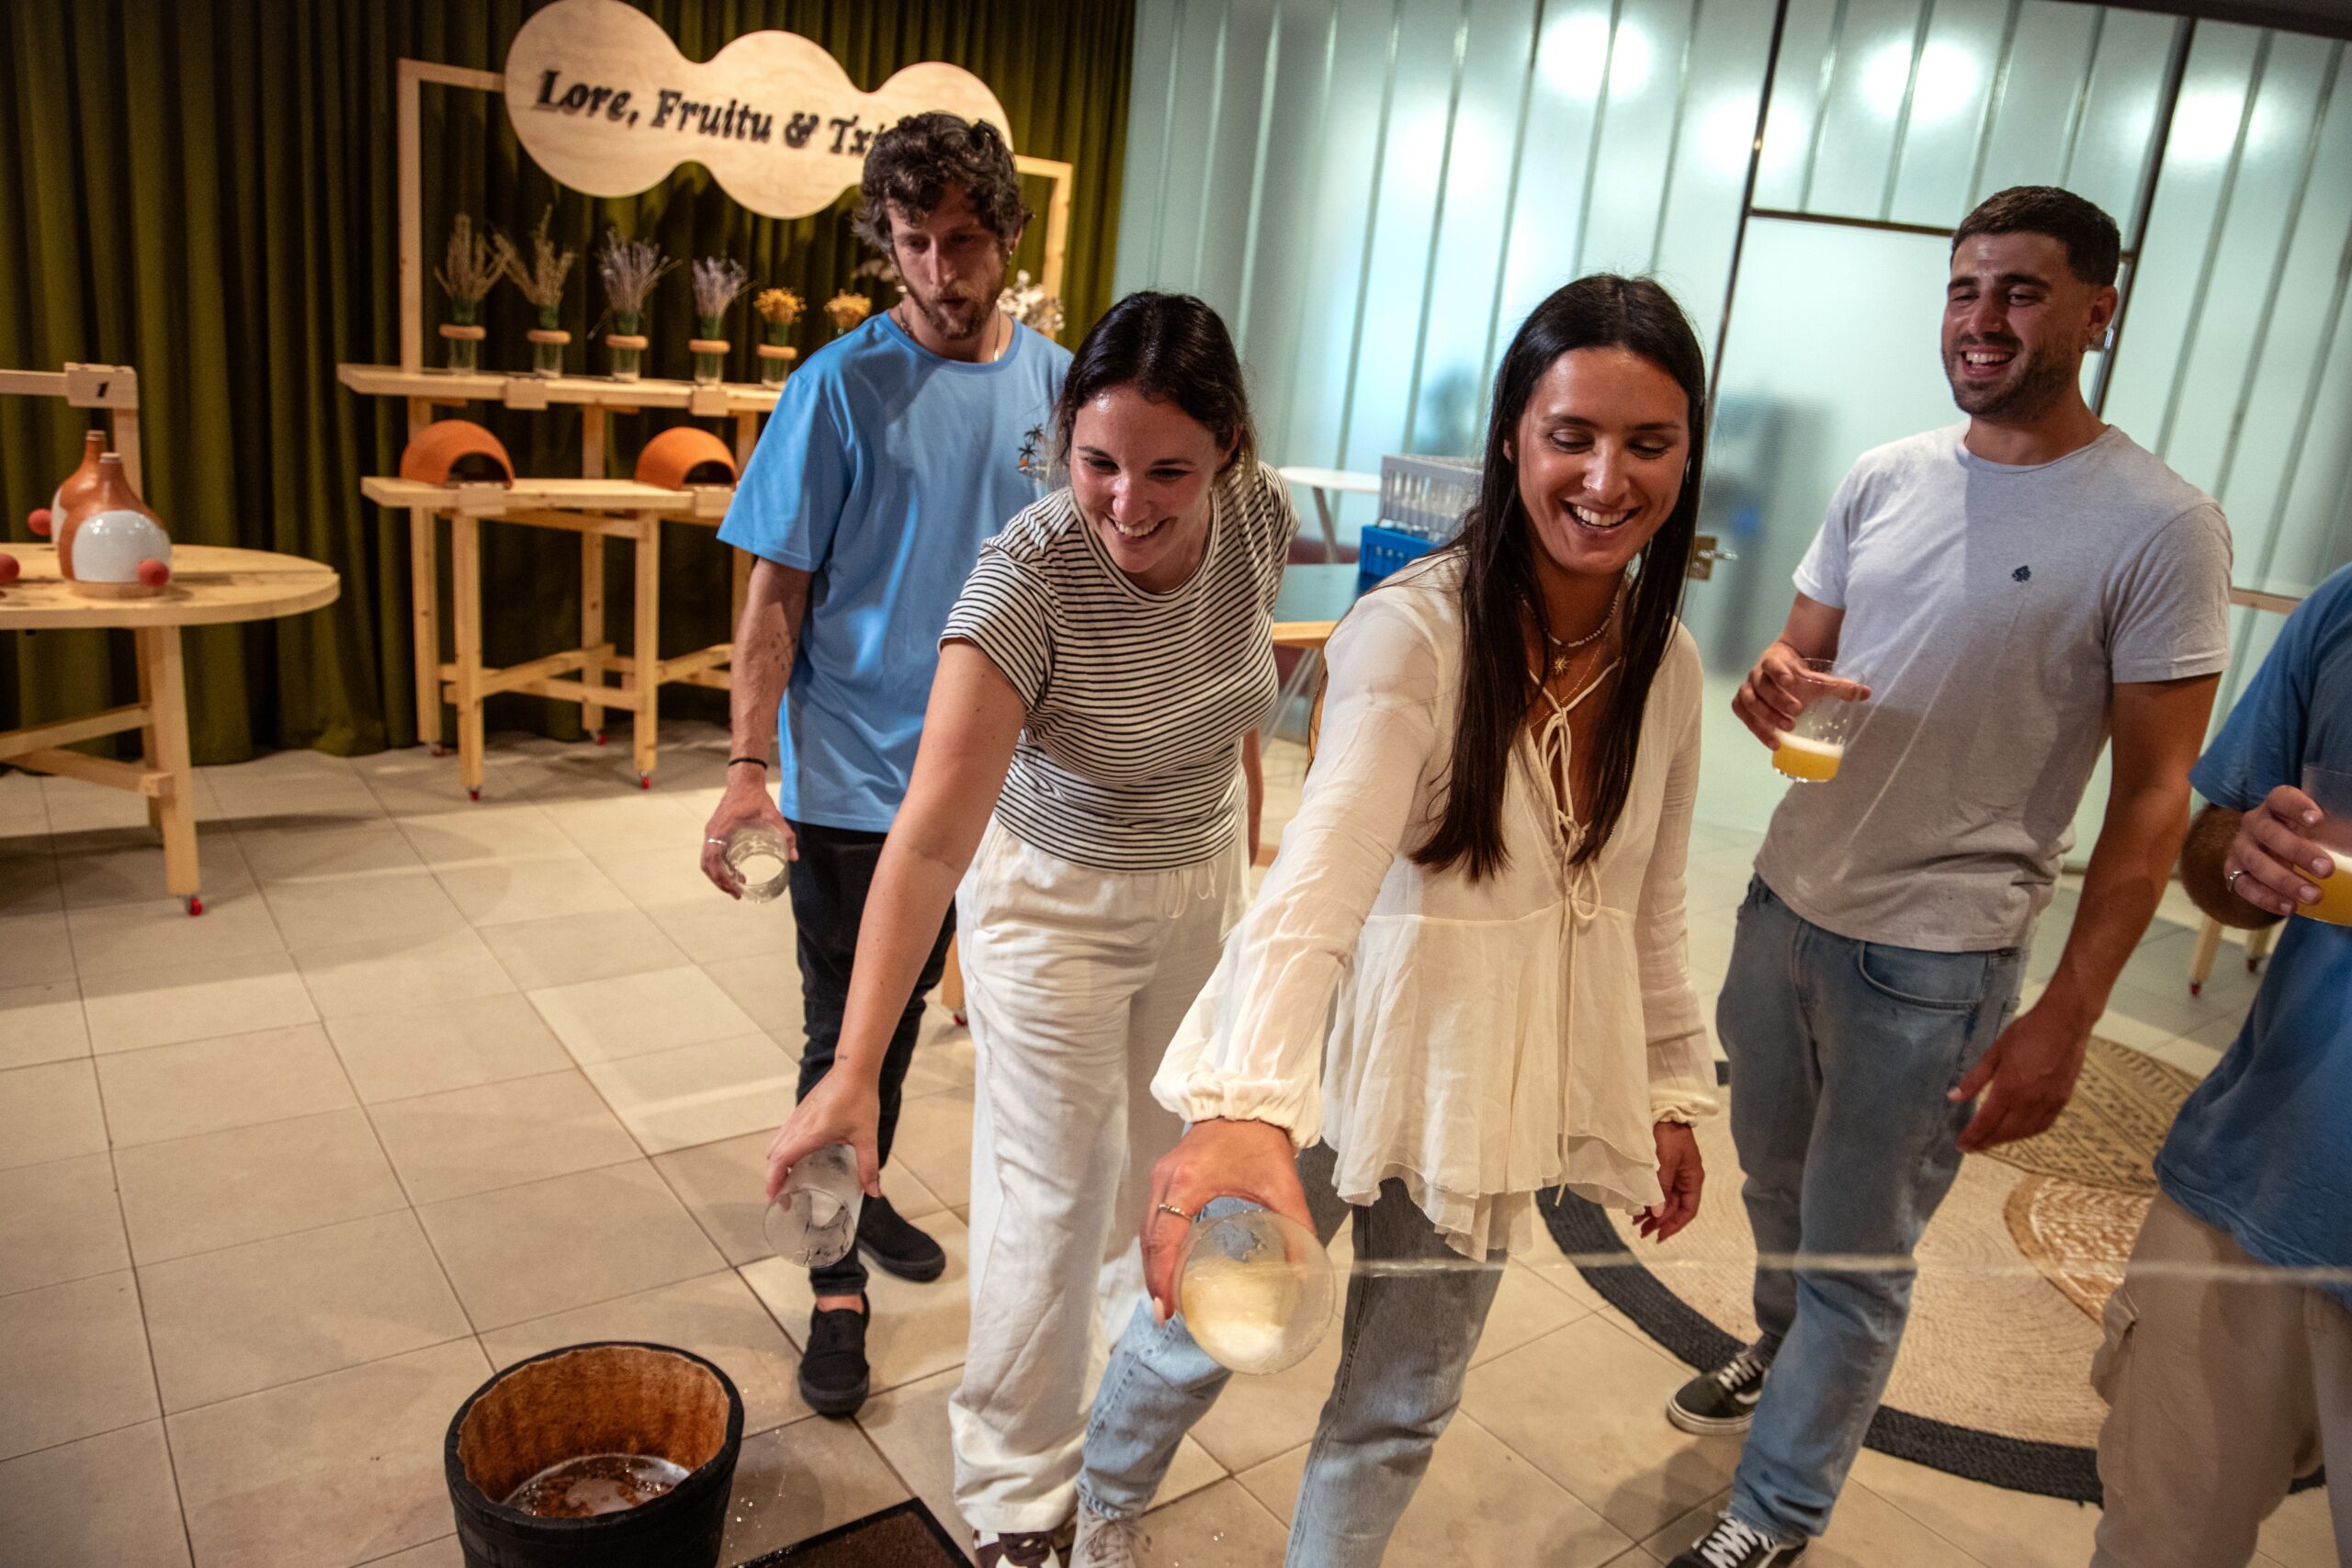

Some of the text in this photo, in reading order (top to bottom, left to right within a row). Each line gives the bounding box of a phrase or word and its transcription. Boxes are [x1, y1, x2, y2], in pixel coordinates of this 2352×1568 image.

[533, 68, 886, 155] Lore, Fruitu & Tx
[96, 381, 109, 398] 1
